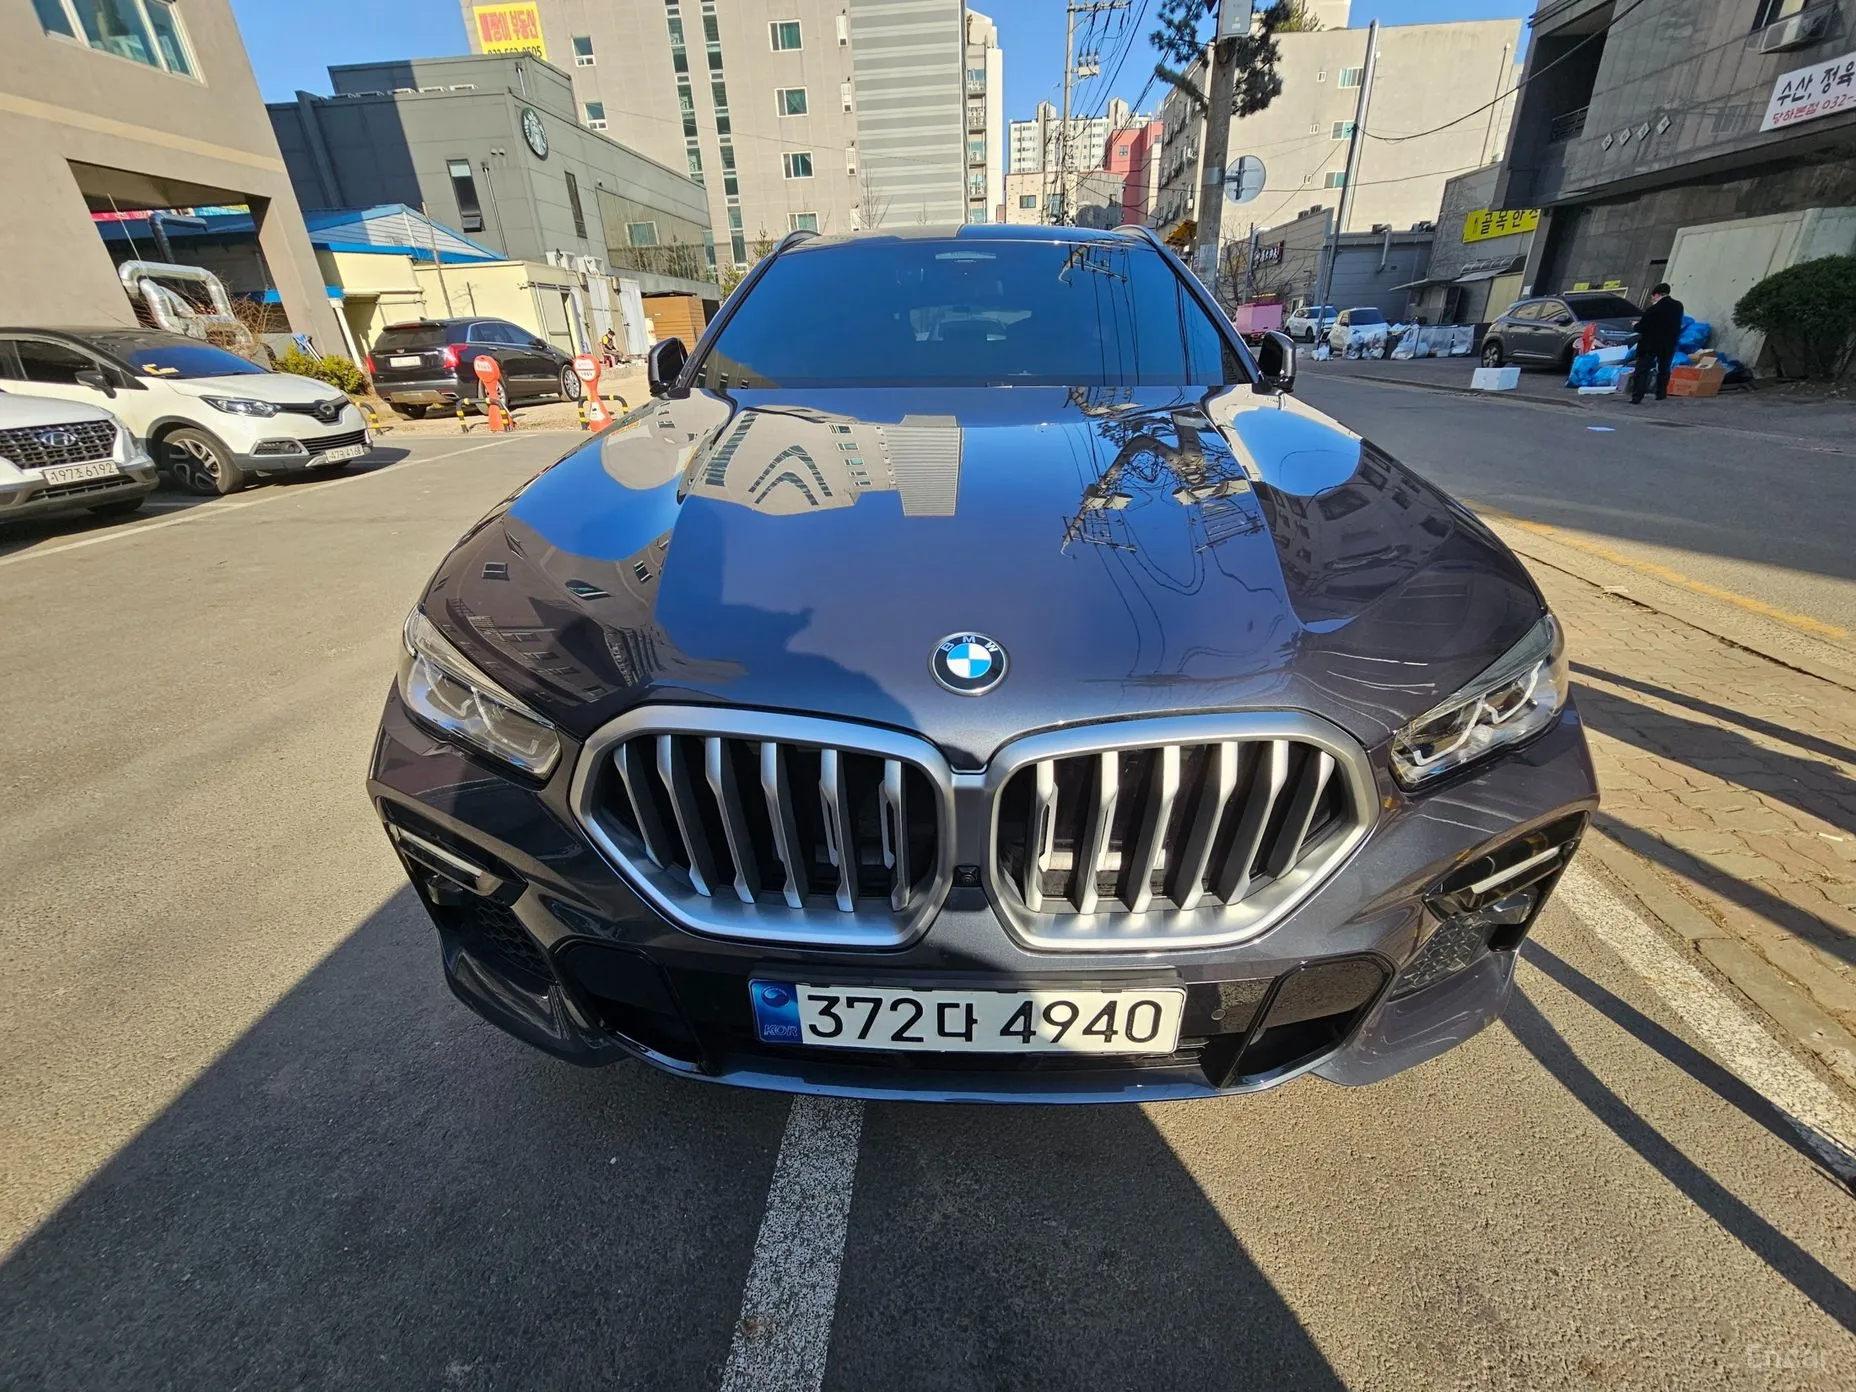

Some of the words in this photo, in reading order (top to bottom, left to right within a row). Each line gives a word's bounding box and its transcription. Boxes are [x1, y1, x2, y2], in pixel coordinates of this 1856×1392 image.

[1777, 73, 1814, 107] 수산,
[1820, 61, 1856, 94] 정육
[1821, 94, 1856, 110] 032-
[86, 463, 115, 477] 6192
[940, 635, 999, 653] BMW
[807, 994, 978, 1043] 372다
[1000, 1000, 1163, 1044] 4940
[763, 1024, 799, 1037] KOR
